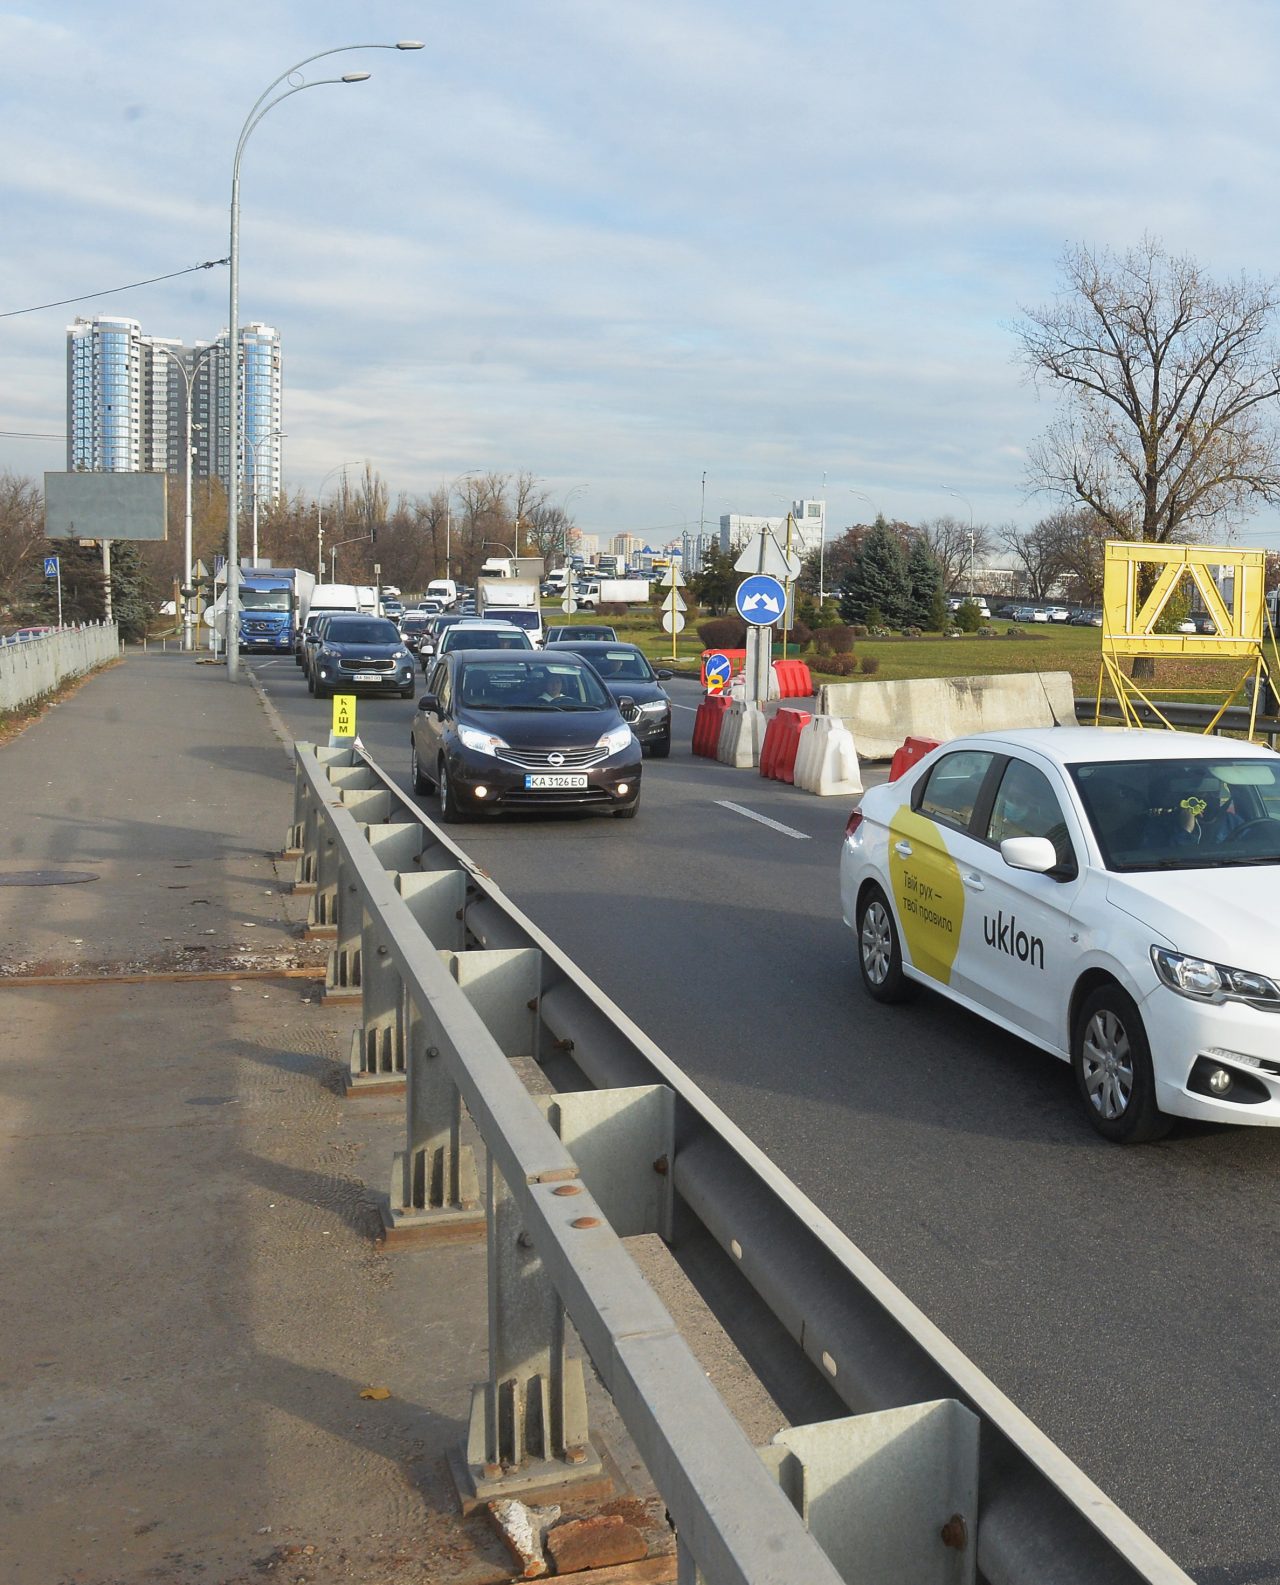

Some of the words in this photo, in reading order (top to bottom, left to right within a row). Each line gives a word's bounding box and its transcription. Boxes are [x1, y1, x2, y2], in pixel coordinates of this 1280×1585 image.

[532, 777, 546, 787] KA
[548, 777, 570, 787] 3126
[571, 777, 585, 787] EO
[903, 870, 918, 892] Твій
[919, 883, 934, 900] рух
[903, 896, 918, 915] твої
[919, 905, 953, 933] правила
[983, 910, 1044, 970] uklon
